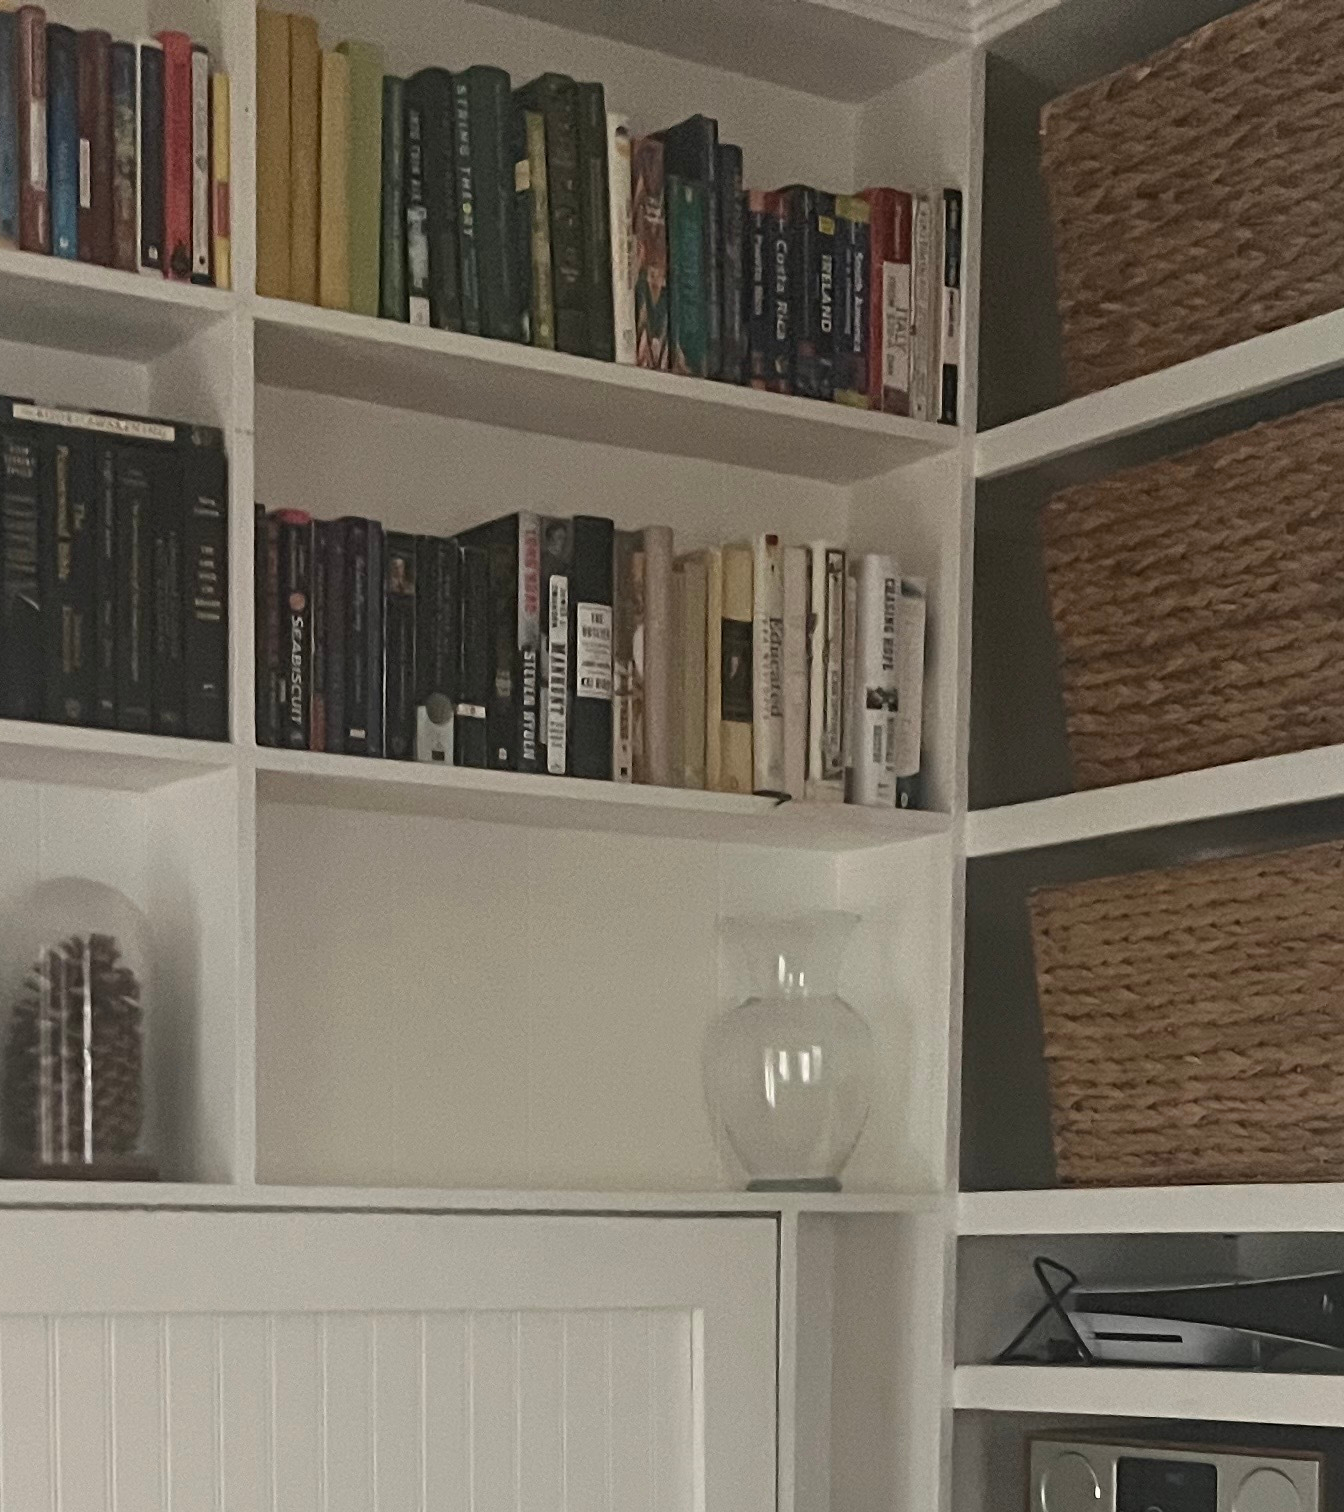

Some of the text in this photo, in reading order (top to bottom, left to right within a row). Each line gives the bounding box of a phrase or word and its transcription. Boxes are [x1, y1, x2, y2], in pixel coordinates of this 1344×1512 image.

[457, 85, 470, 157] STRING
[460, 166, 474, 238] THEORY
[775, 239, 788, 341] Costa Rica
[820, 254, 833, 333] IRELAND
[853, 251, 864, 352] South America
[895, 305, 909, 351] ITALY
[882, 578, 896, 671] CHASING HOPE
[291, 614, 304, 724] SEABISCUIT
[523, 650, 536, 706] STEVEN
[550, 642, 567, 716] MANHUNT
[769, 617, 784, 718] Educated
